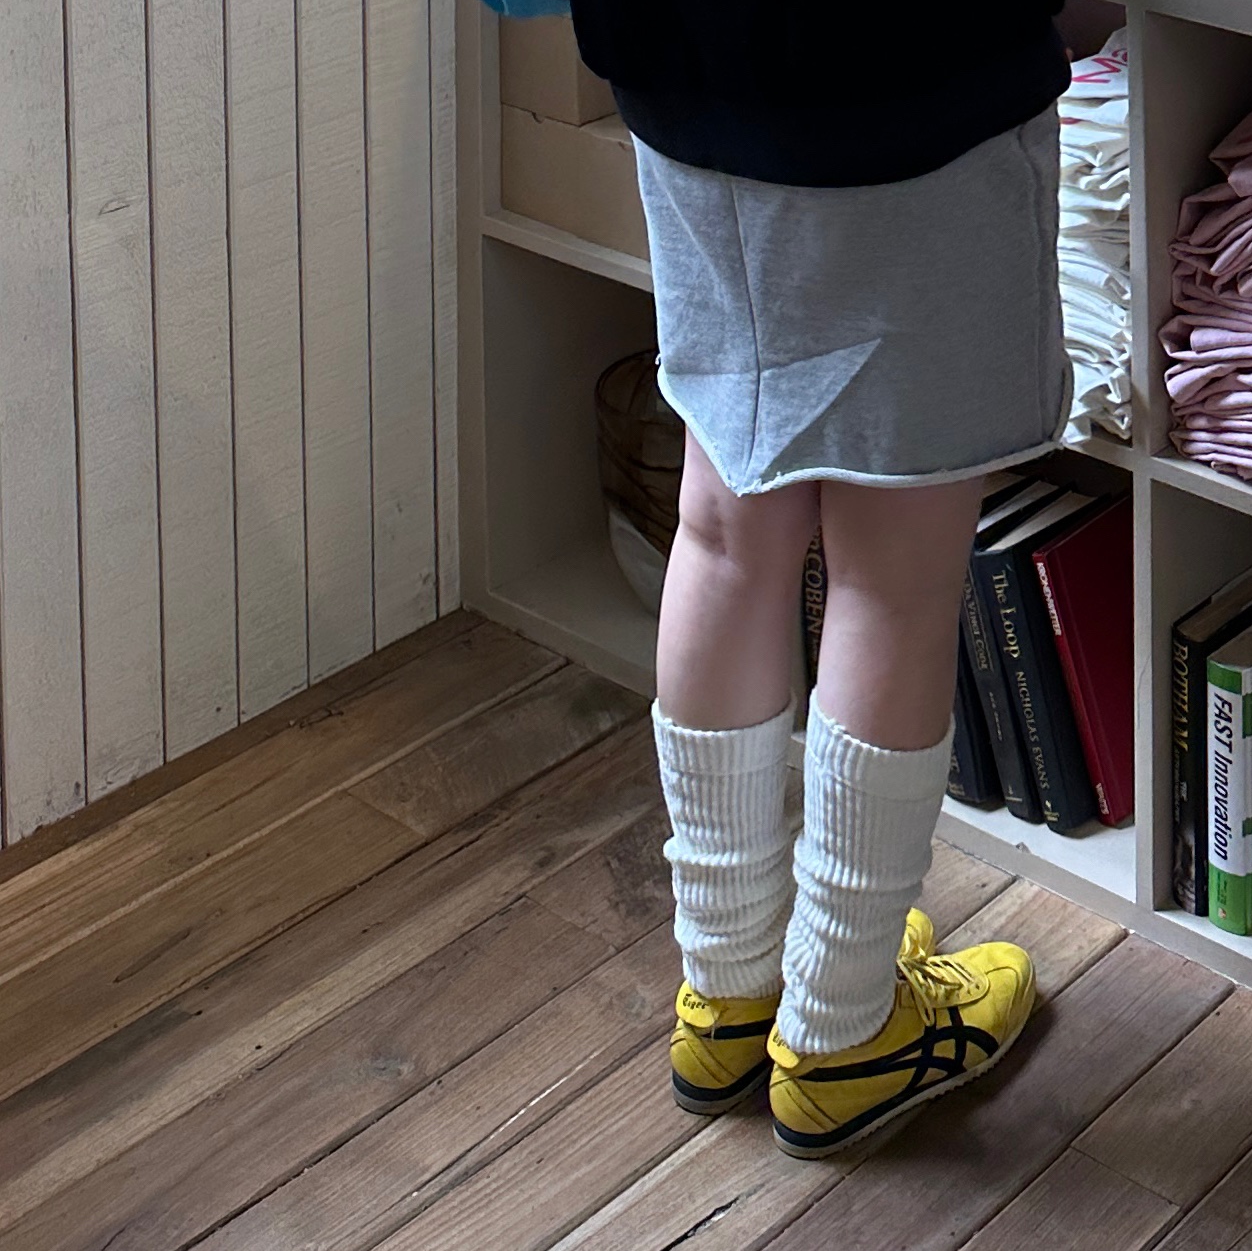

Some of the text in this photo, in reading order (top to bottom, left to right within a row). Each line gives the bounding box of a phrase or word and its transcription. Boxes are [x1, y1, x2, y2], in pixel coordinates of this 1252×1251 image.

[804, 551, 826, 635] COBEN
[992, 571, 1050, 789] The Loop NICHOLAS EVANS
[1173, 643, 1189, 751] BOTHAM
[1213, 692, 1233, 752] FAST
[1213, 748, 1233, 862] Innovation
